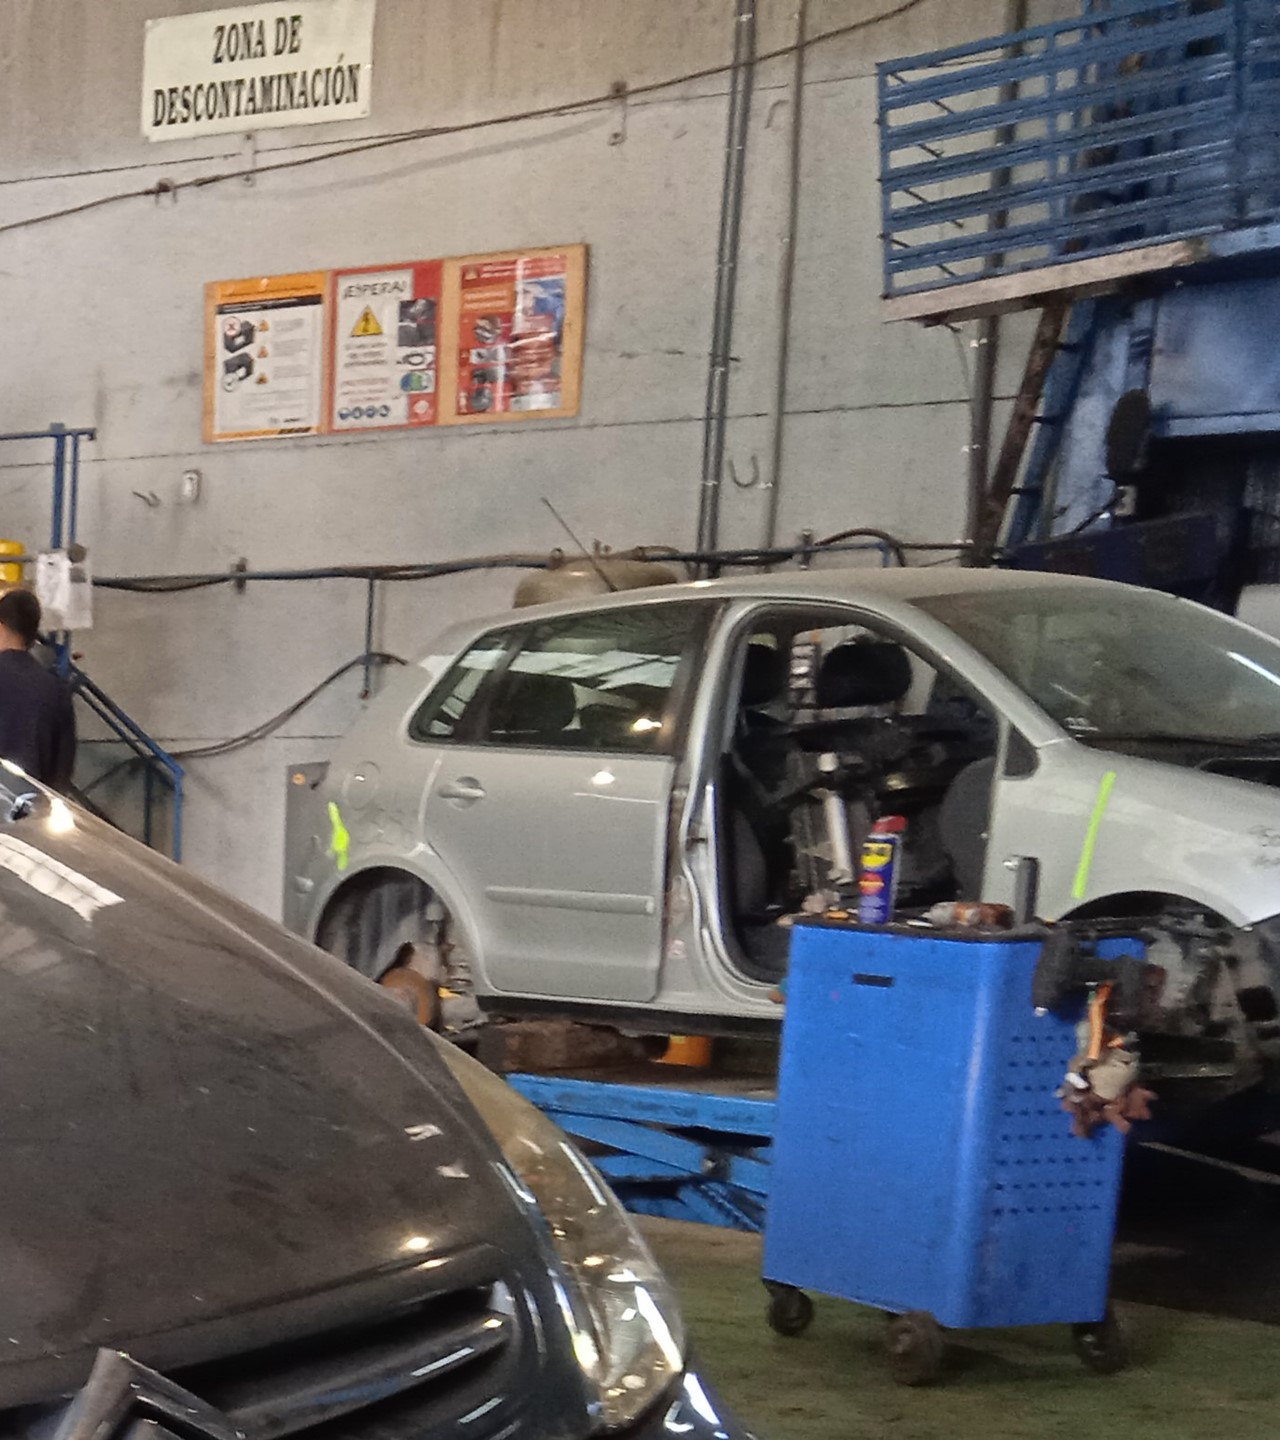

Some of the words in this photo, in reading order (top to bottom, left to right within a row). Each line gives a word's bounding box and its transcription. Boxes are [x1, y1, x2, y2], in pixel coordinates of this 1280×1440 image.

[211, 18, 267, 64] ZONA
[272, 14, 304, 56] DE
[151, 52, 362, 127] DESCONTAMINACIÓN
